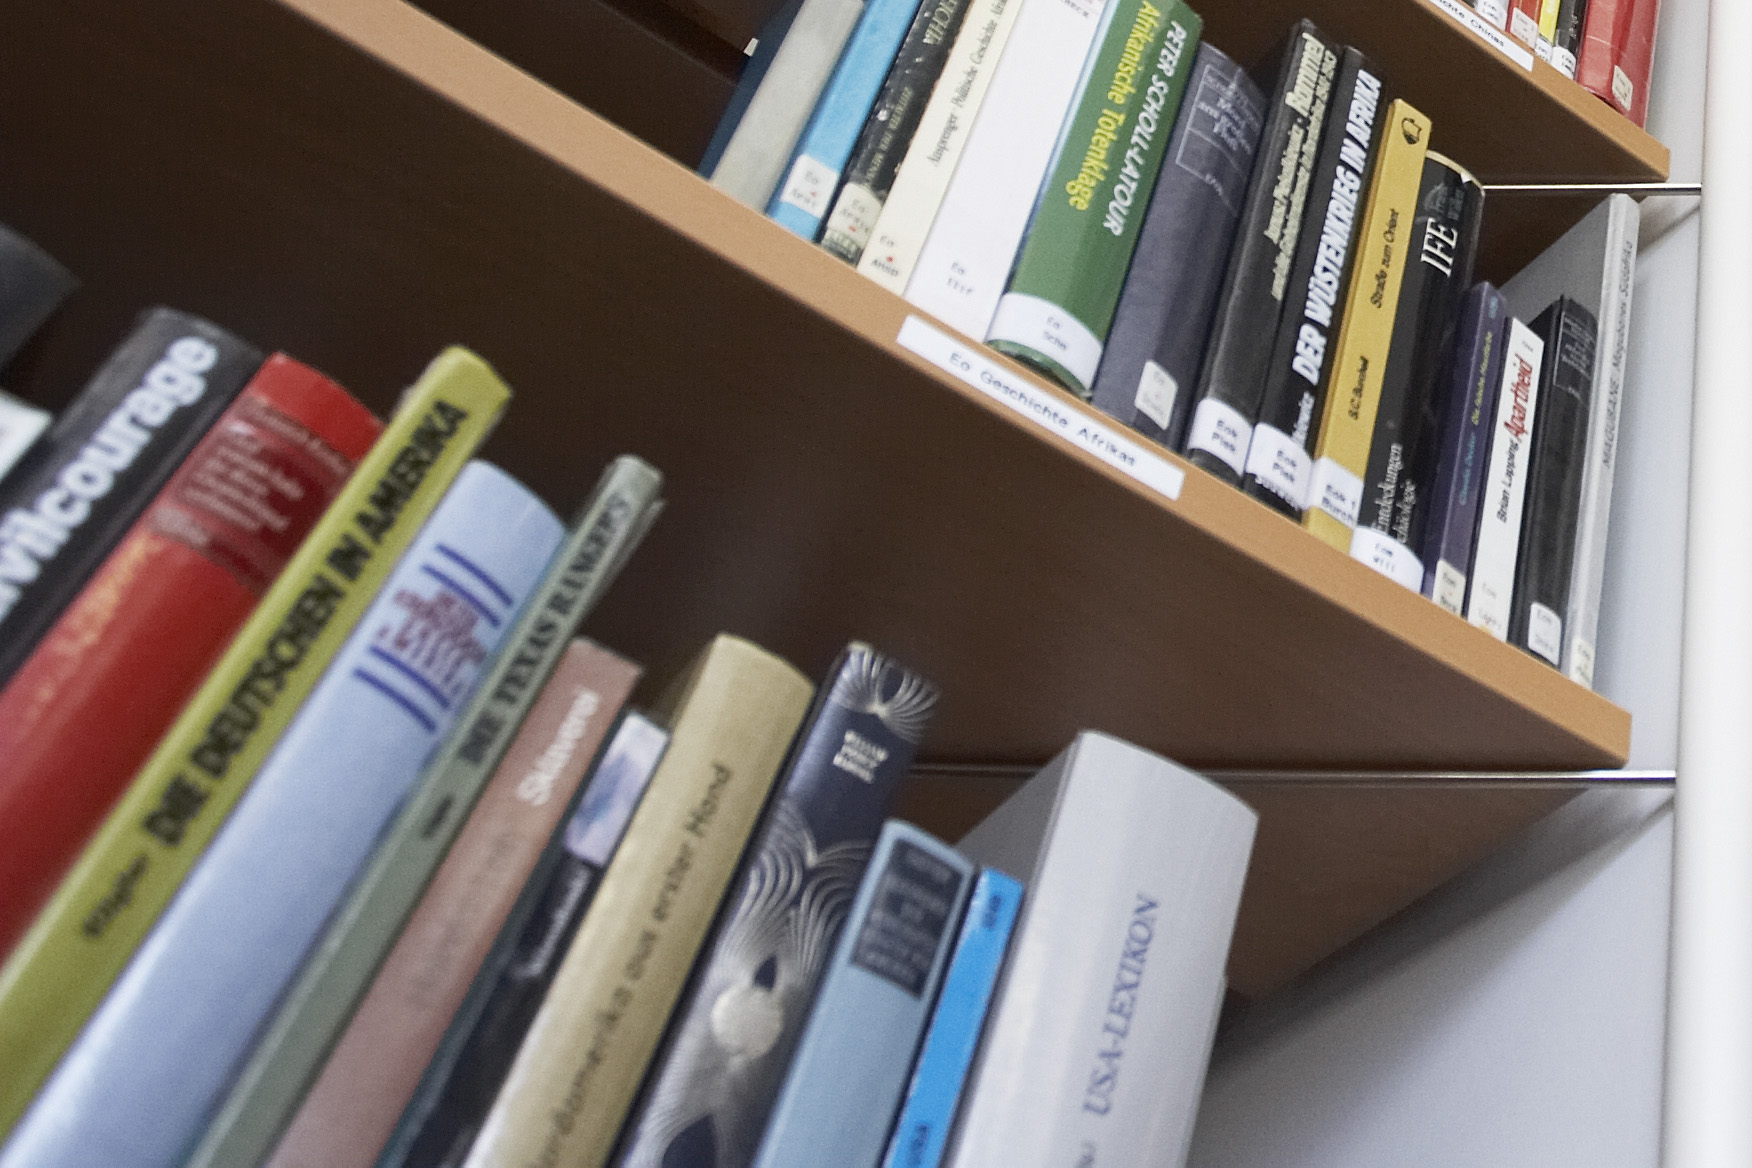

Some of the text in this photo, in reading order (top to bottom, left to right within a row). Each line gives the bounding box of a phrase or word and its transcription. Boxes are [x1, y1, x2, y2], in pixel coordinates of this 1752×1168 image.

[969, 17, 998, 66] Geschichte
[1285, 31, 1324, 117] Rommel
[1468, 18, 1506, 48] Chinas
[1058, 0, 1164, 214] Afrikanische Totenklage
[1101, 18, 1190, 238] PETER SCHOLL-LATOUR
[1341, 67, 1384, 149] AFRIKA
[1335, 142, 1368, 171] IN
[1299, 165, 1364, 327] WÜSTENKRIEG
[1420, 218, 1458, 276] IFE
[1287, 322, 1330, 385] DER
[946, 351, 1138, 467] Eo Geschichte Afrikas
[1495, 352, 1535, 524] Brian Lapping Apartheid
[353, 398, 468, 544] AMERIKA
[335, 530, 378, 584] IN
[188, 576, 346, 779] DEUTSCHEN
[489, 611, 564, 705] TEXAS
[144, 774, 210, 847] DIE
[681, 759, 735, 841] Hand
[1082, 889, 1162, 1119] USA-LEXIKON
